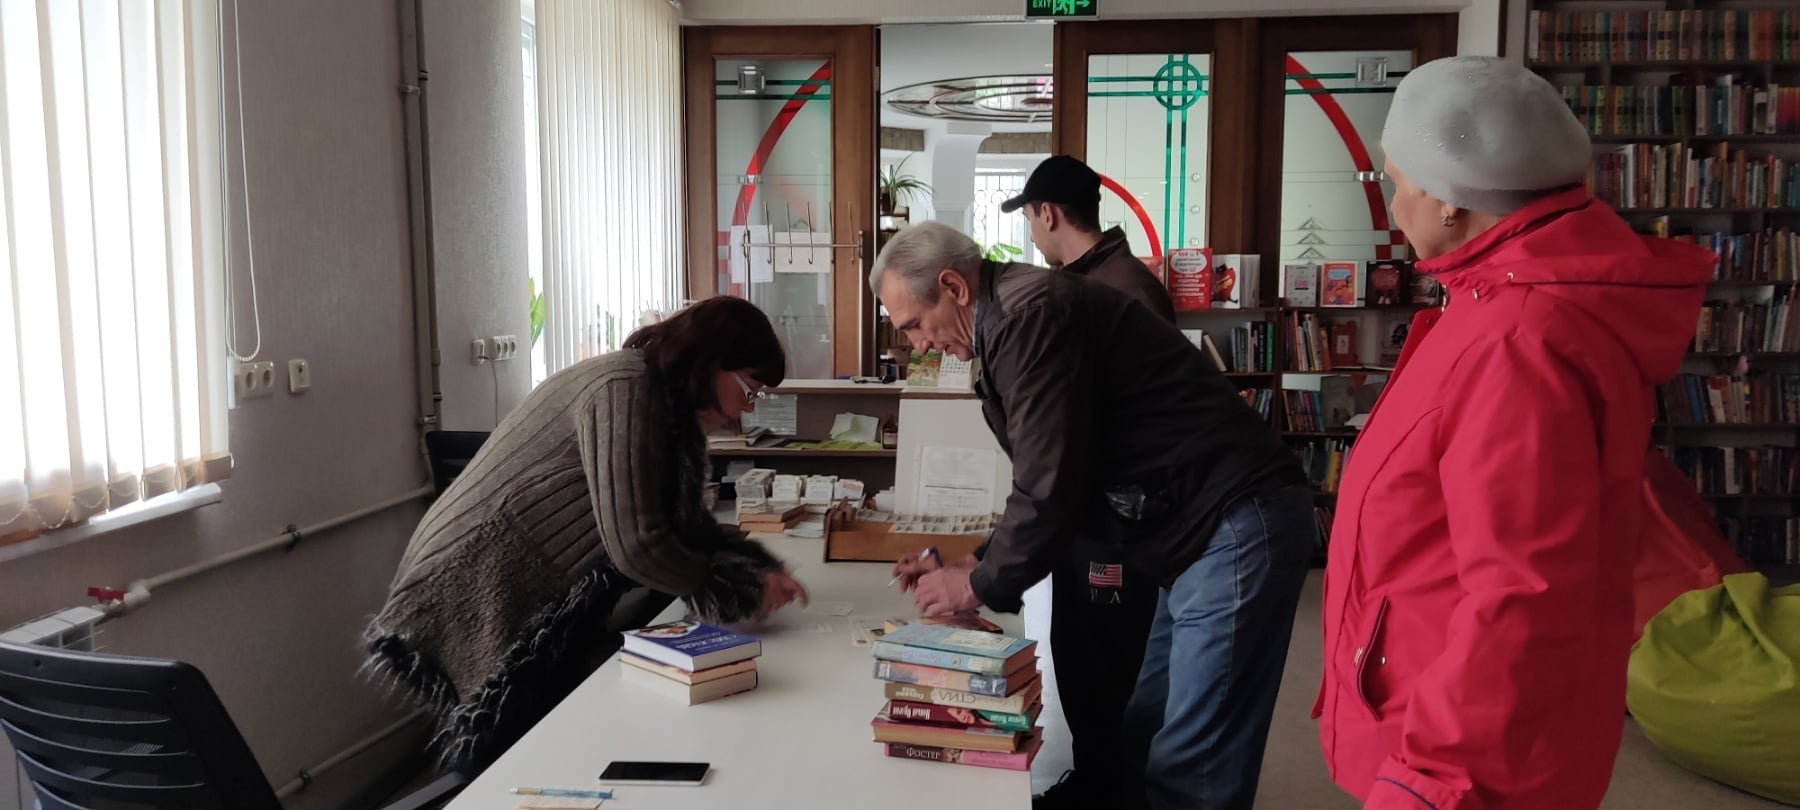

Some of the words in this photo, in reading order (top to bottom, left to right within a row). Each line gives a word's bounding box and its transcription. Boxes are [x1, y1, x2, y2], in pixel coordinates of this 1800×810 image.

[1032, 0, 1051, 8] EXIT
[938, 691, 977, 704] СТИЛ
[906, 747, 941, 760] ФОСТЕР
